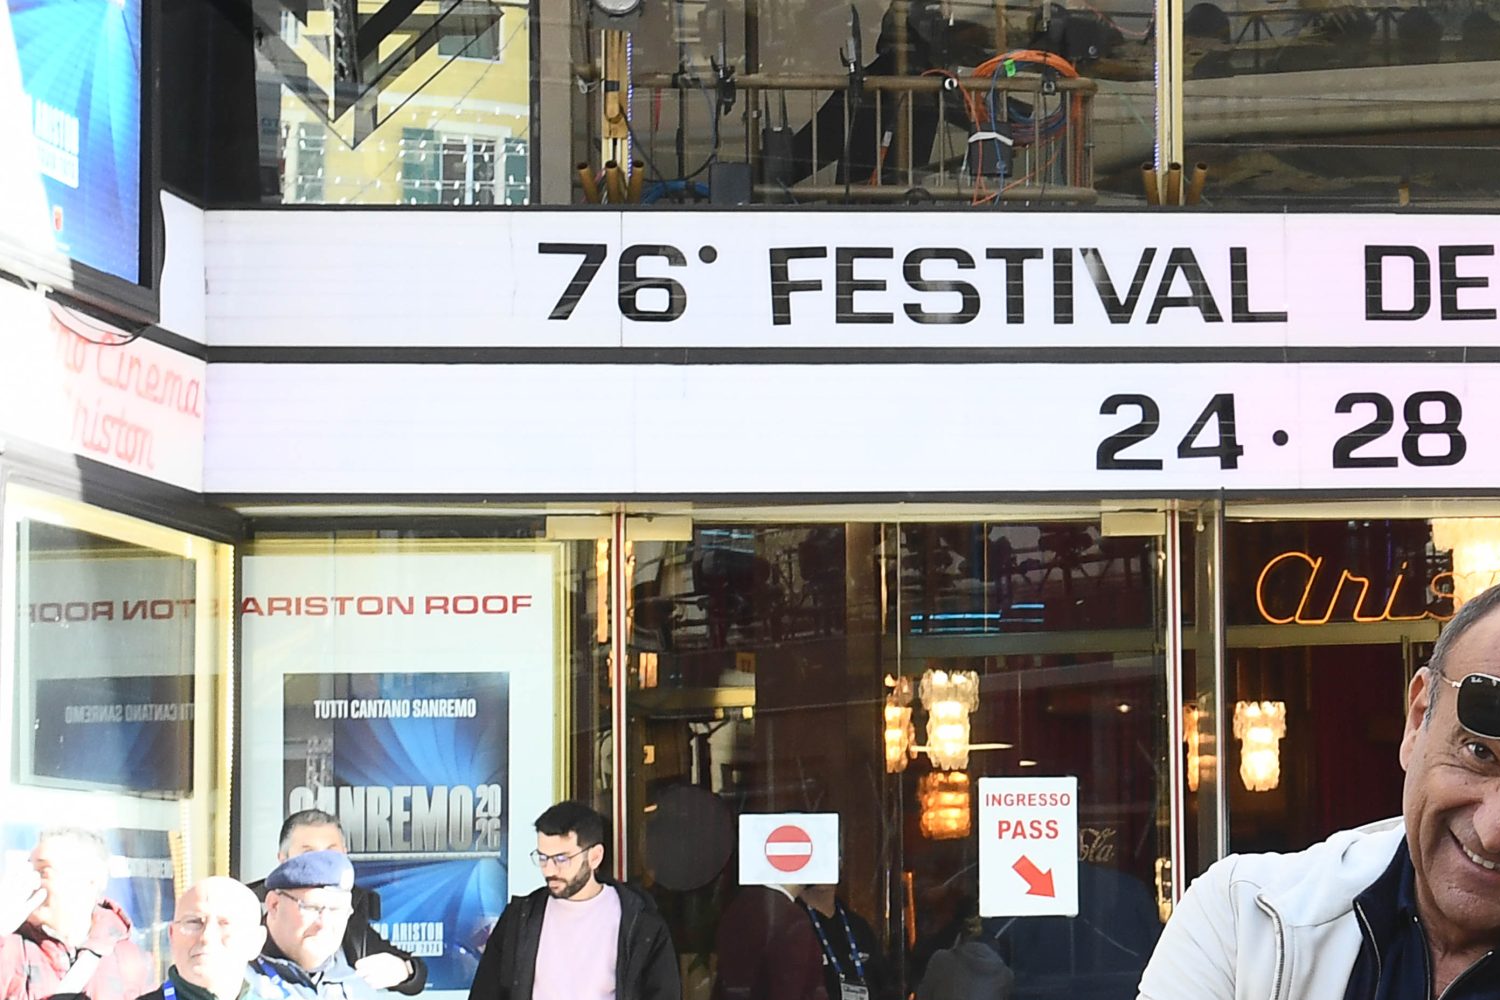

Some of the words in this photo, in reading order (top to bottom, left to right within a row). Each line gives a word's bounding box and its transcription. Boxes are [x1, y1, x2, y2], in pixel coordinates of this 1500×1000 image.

[769, 245, 1288, 326] FESTIVAL
[62, 382, 155, 470] riston
[1096, 393, 1244, 471] 24
[1332, 391, 1467, 469] 28
[241, 596, 415, 617] ARISTON
[425, 595, 532, 615] ROOF
[313, 700, 349, 719] TUTTI
[350, 699, 411, 719] CANTANO
[412, 698, 477, 719] SANREMO
[475, 783, 502, 817] 20
[985, 793, 1071, 807] INGRESSO
[997, 819, 1059, 840] PASS
